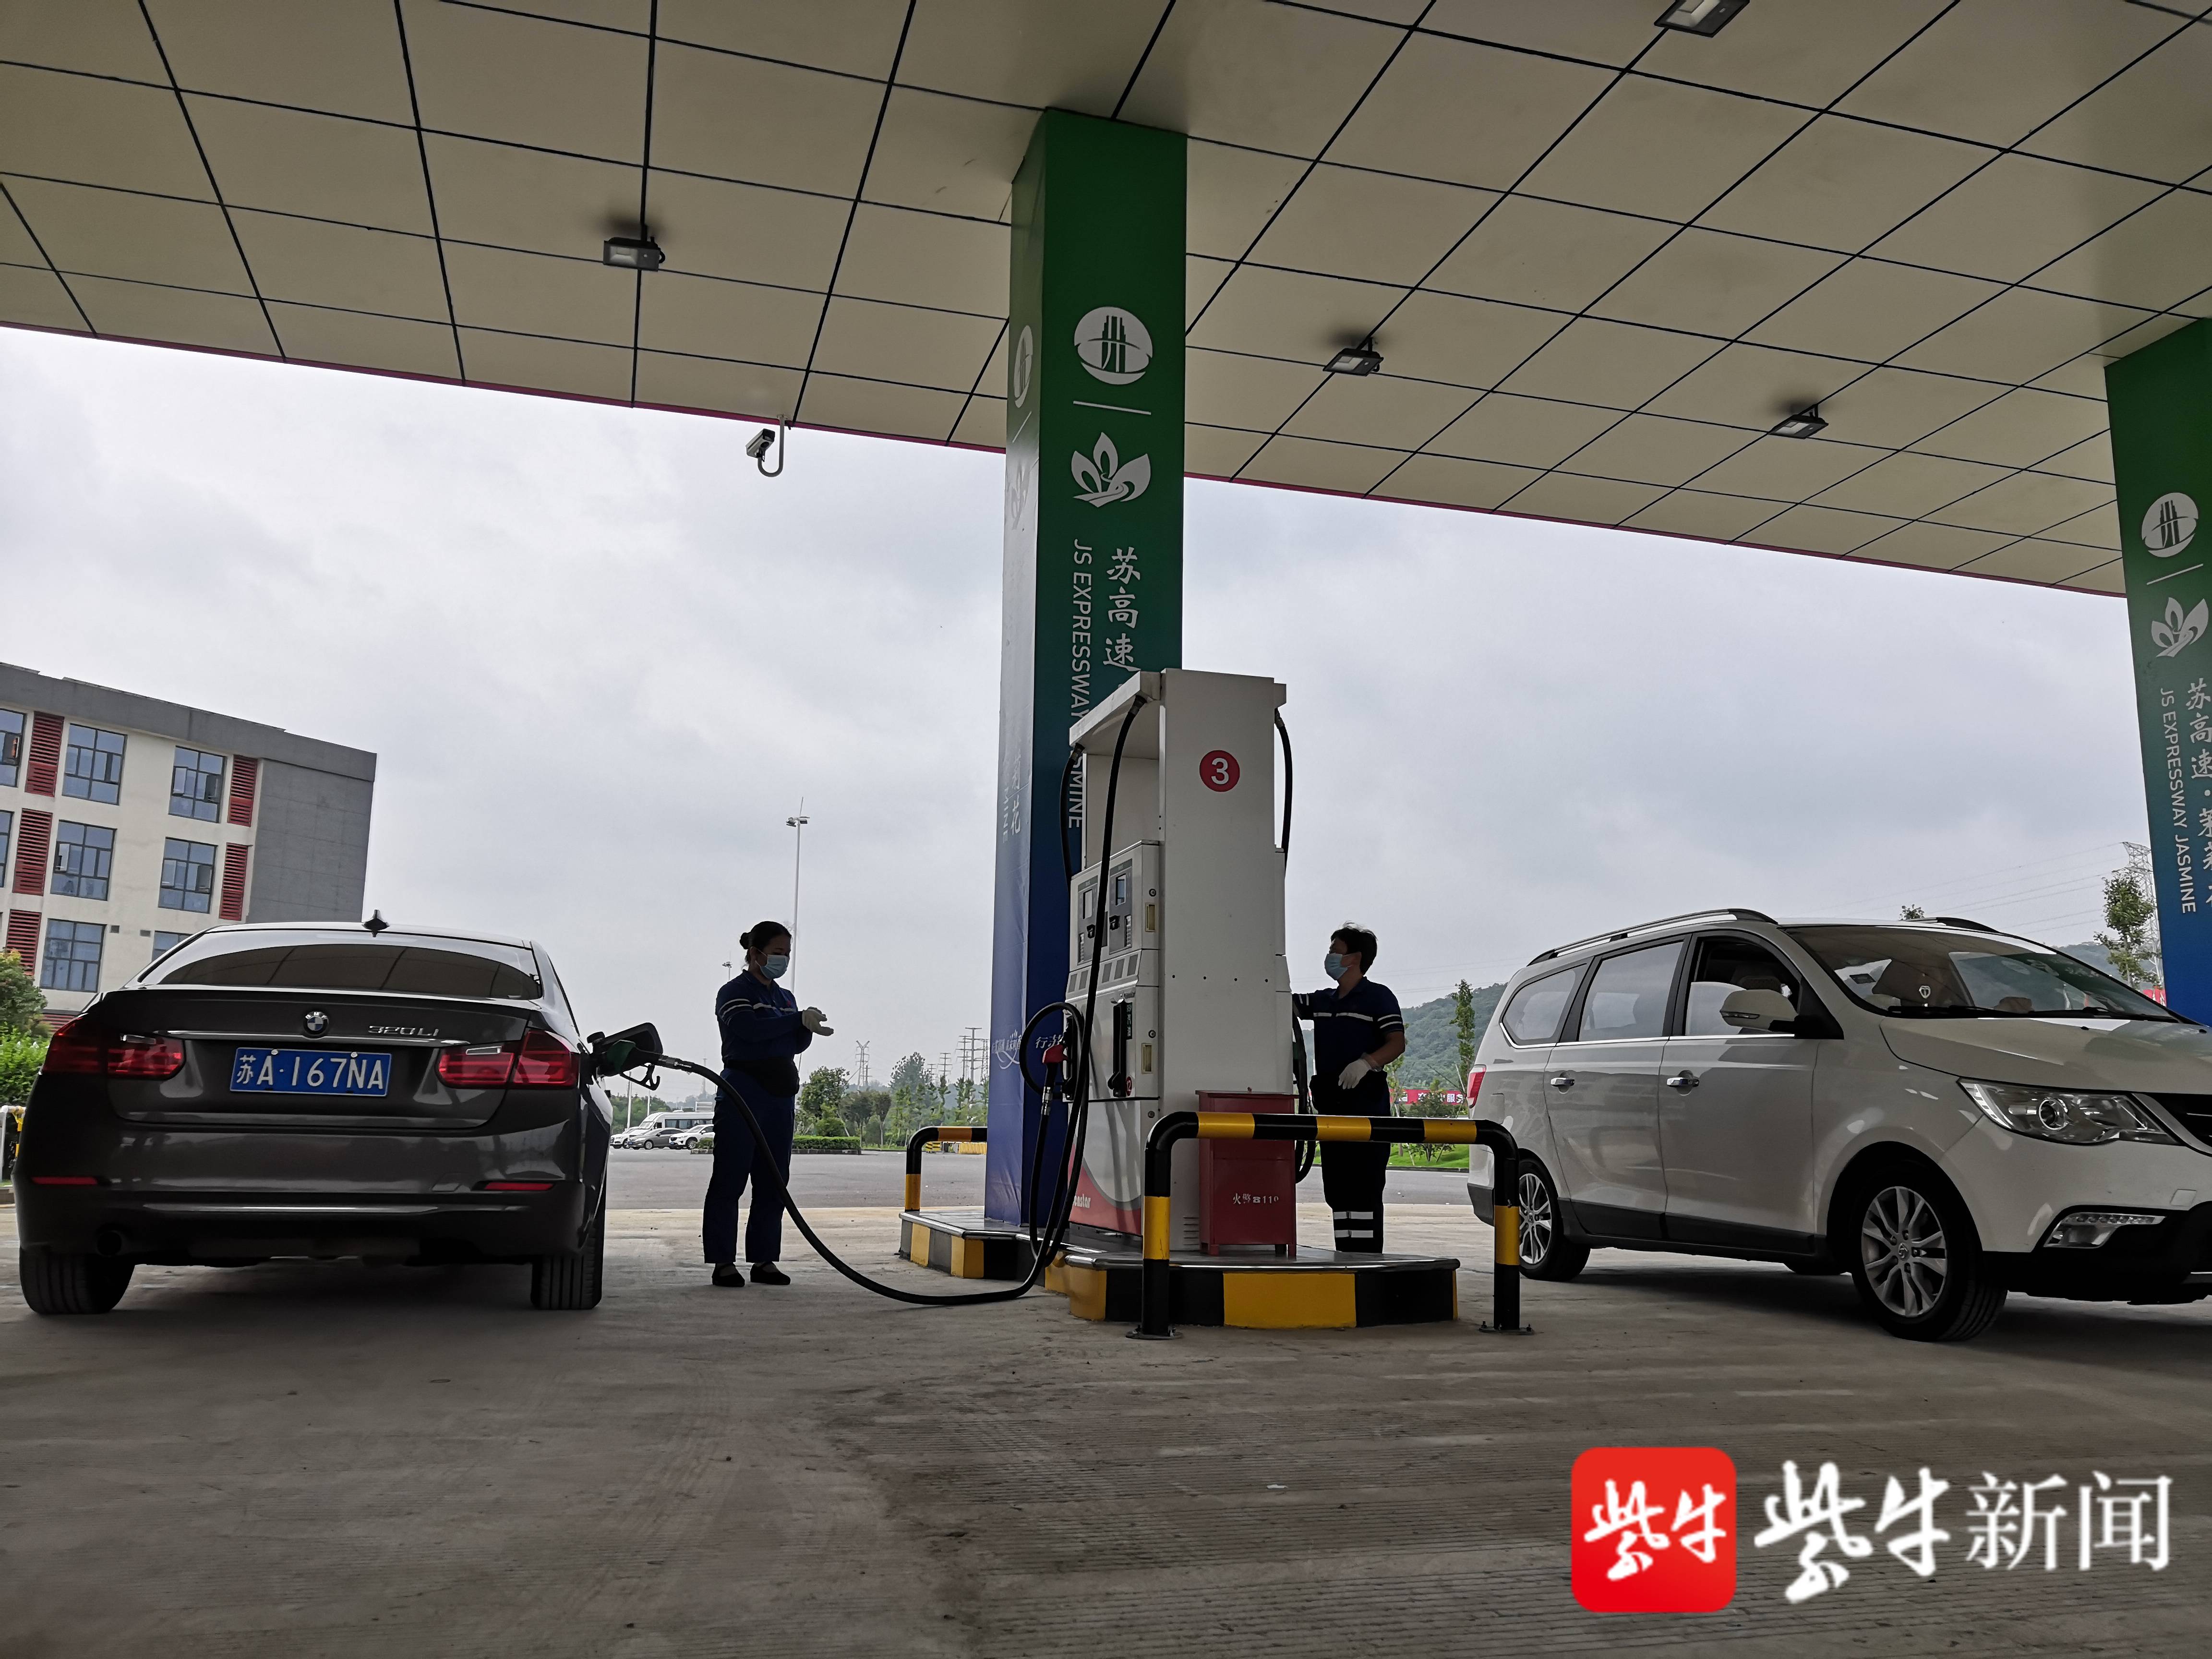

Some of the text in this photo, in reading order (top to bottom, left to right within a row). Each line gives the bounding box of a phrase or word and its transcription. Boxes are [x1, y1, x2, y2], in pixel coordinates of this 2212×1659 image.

[1073, 539, 1093, 565] JS
[1071, 572, 1092, 719] EXPRESSWAY
[1211, 757, 1229, 785] 3
[2161, 687, 2196, 914] JS EXPRESSWAY JASMINE
